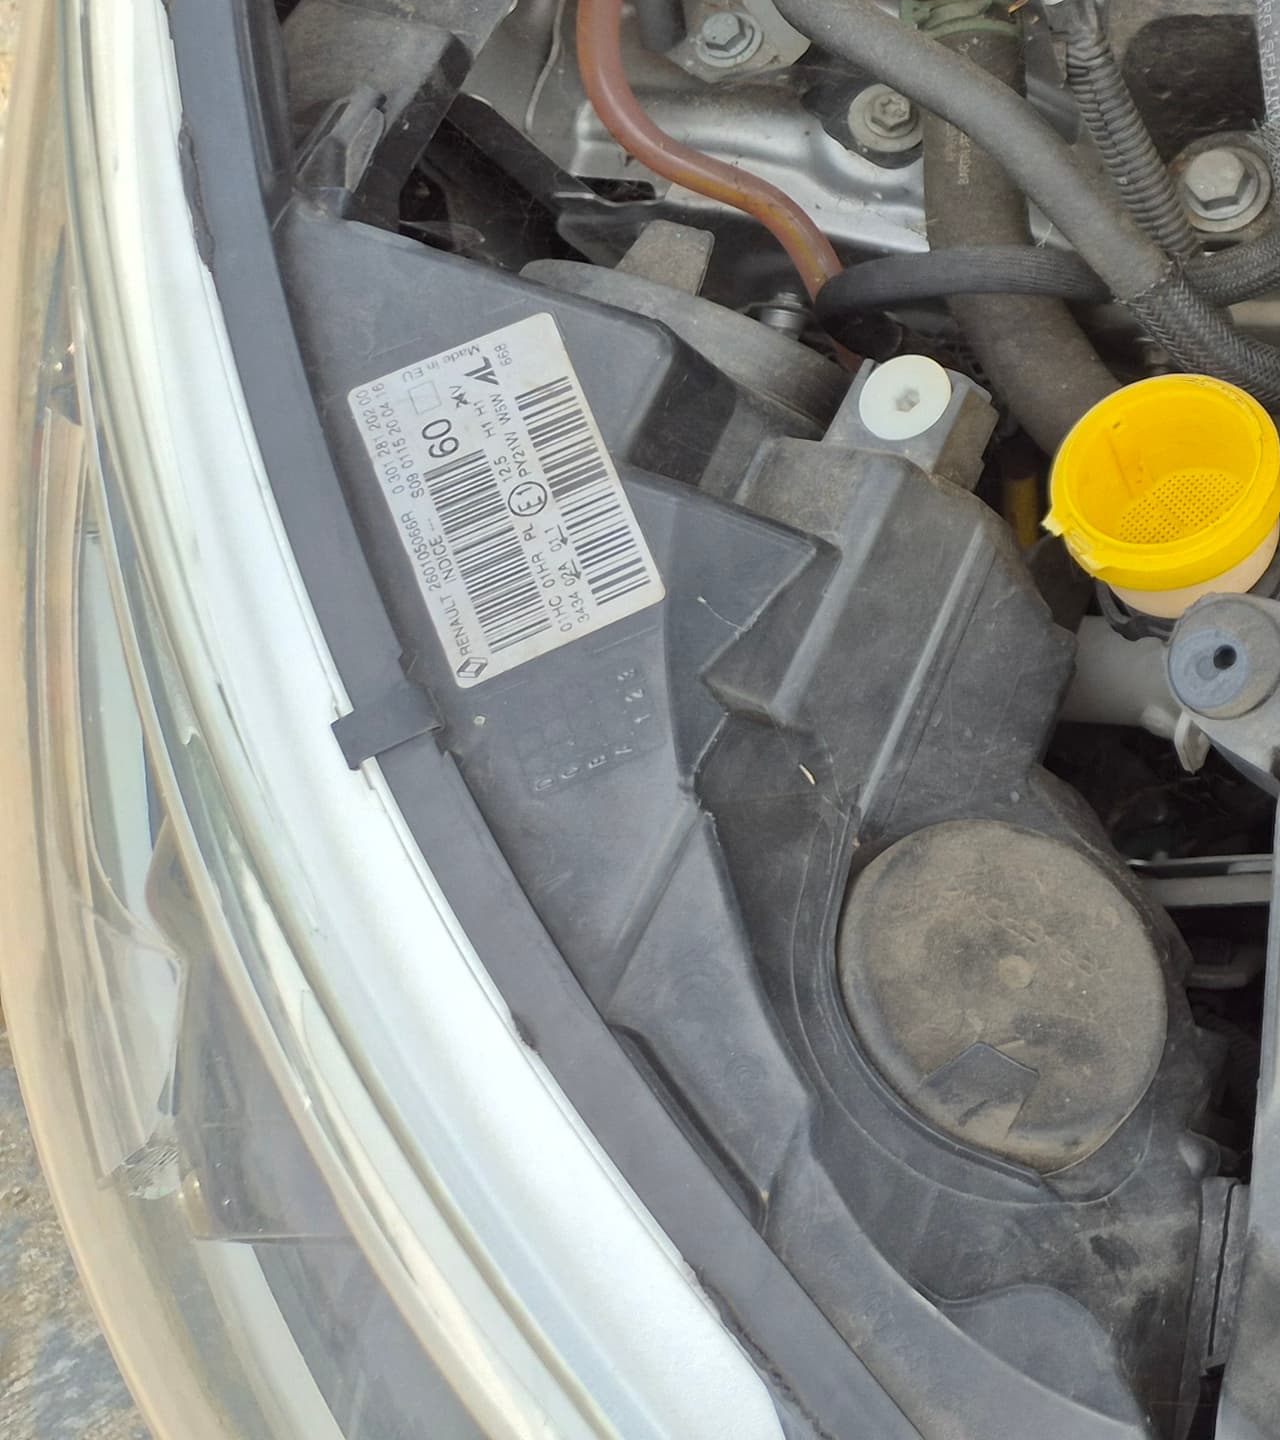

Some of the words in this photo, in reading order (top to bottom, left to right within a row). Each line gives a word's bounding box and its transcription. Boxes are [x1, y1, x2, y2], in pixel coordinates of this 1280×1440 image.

[427, 359, 441, 371] in
[441, 343, 480, 367] Made
[401, 366, 425, 383] EU
[489, 392, 512, 426] W5W
[419, 416, 462, 462] 60
[503, 429, 533, 478] PY21W
[519, 523, 537, 542] PL
[399, 510, 443, 592] 260105066R
[428, 535, 458, 584] INDICE
[530, 551, 556, 590] 01HR
[438, 592, 475, 657] RENAULT
[567, 590, 591, 624] 3434
